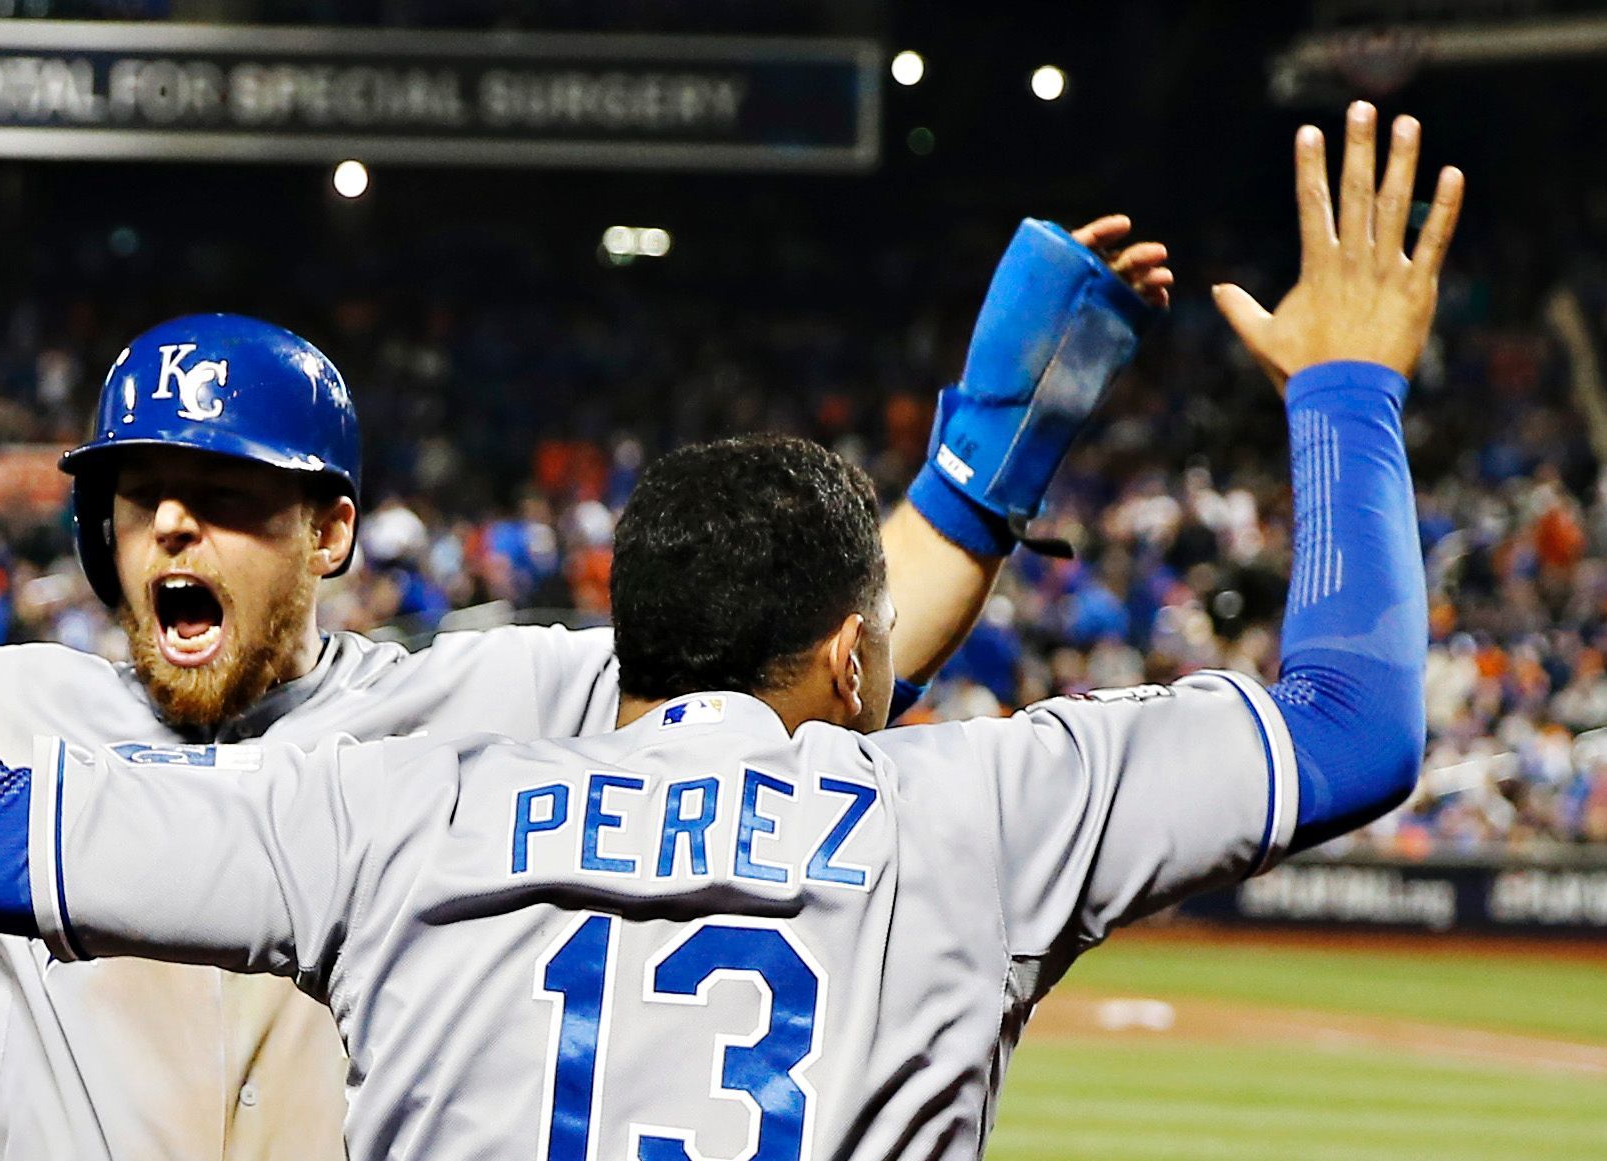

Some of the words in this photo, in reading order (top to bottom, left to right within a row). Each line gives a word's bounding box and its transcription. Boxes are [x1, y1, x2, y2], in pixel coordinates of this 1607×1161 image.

[109, 58, 225, 124] FOR
[227, 62, 465, 127] SPECIAL
[478, 66, 747, 129] SURGERY
[151, 344, 228, 421] KC
[507, 761, 881, 892] PEREZ
